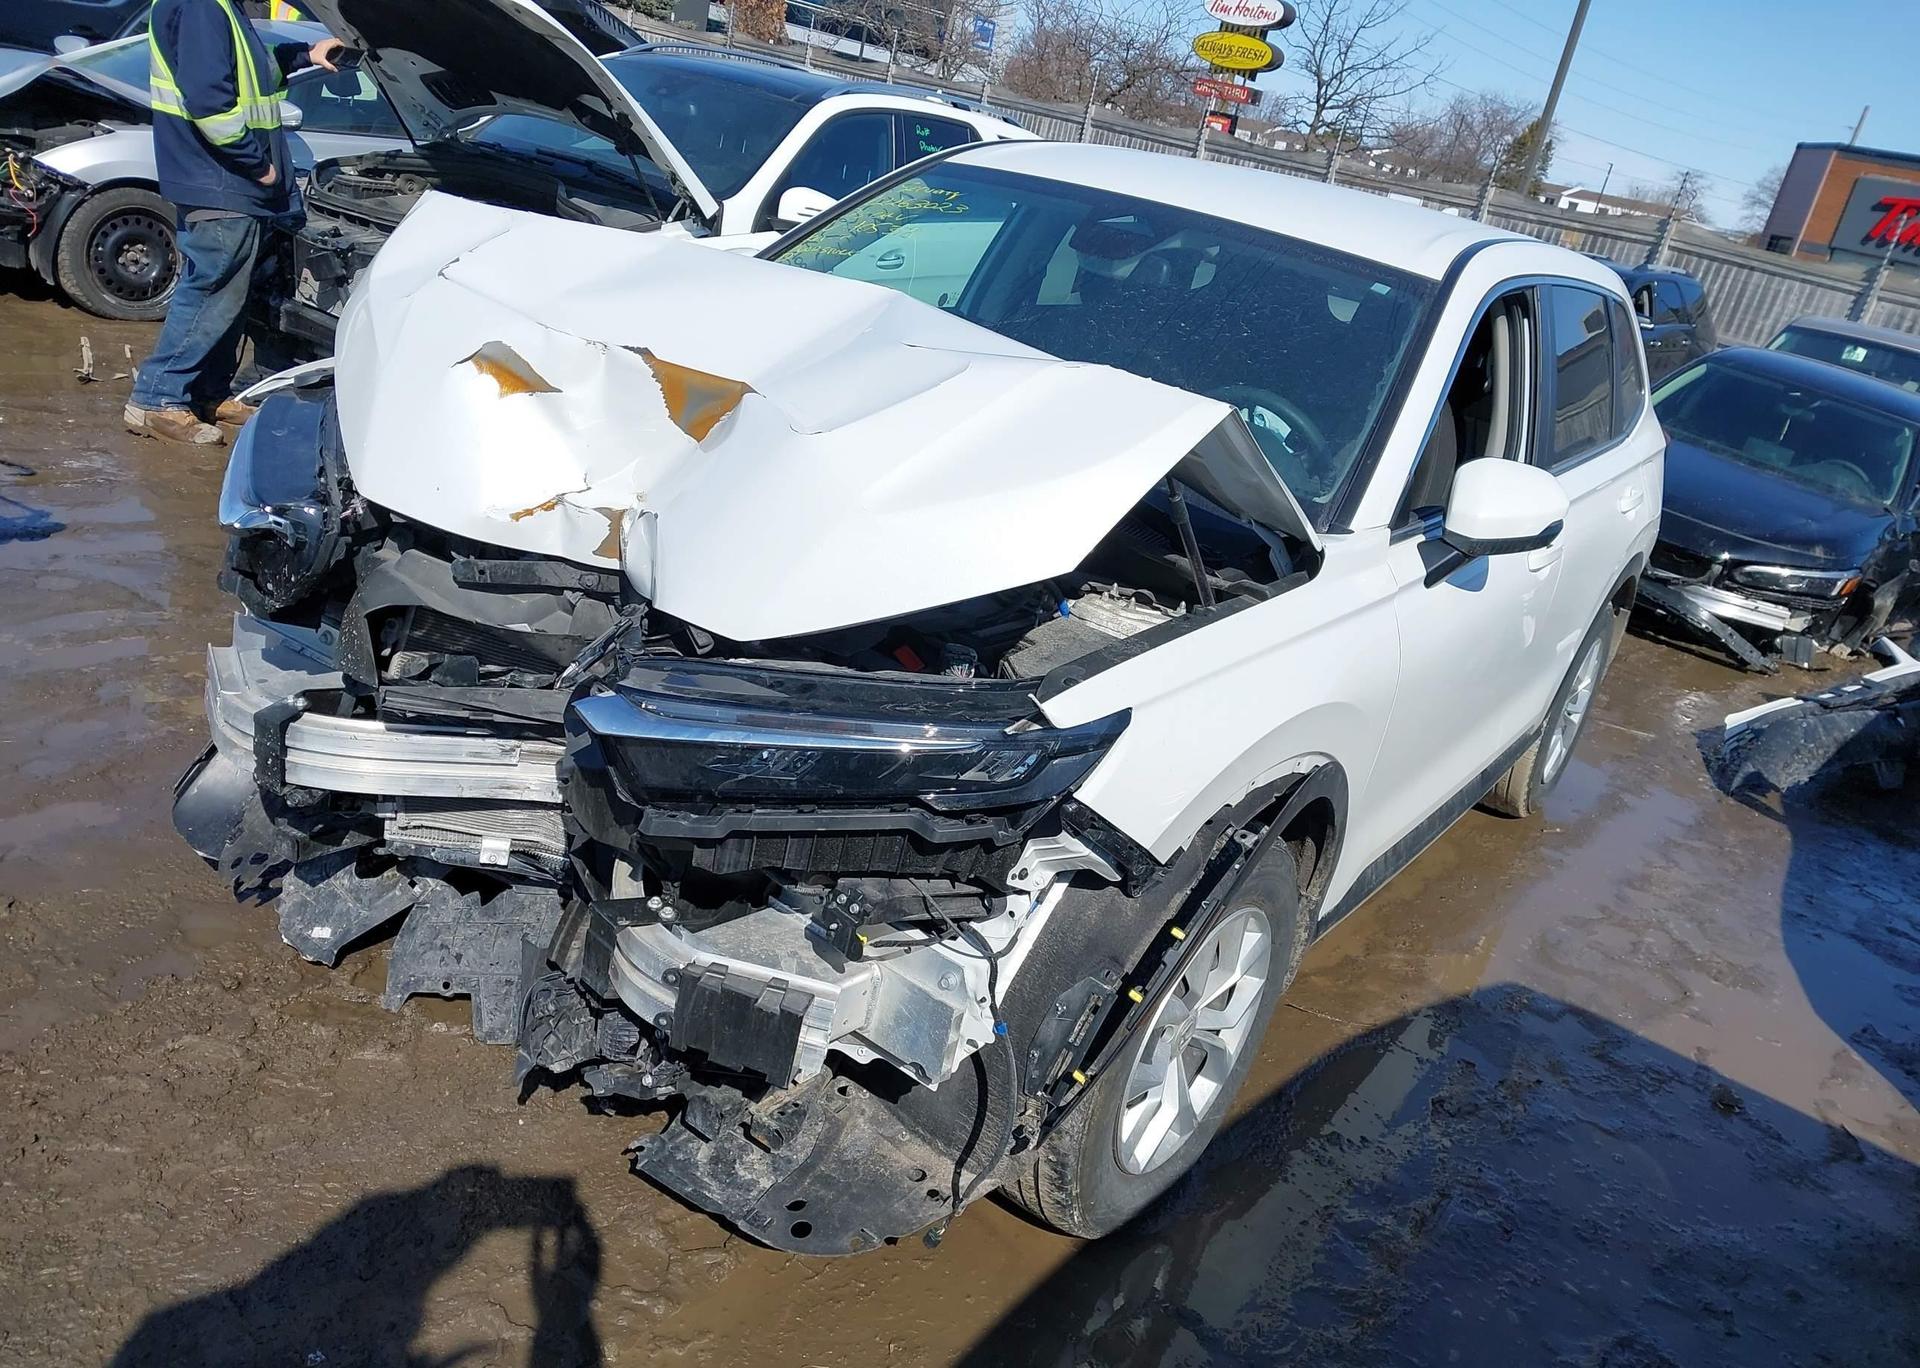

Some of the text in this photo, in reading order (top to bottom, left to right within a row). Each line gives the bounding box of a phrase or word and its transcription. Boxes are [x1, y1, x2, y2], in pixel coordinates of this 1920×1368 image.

[1210, 0, 1278, 20] Tim Hortons
[1197, 40, 1267, 62] ALWAYS FRESH
[1223, 86, 1248, 100] THRU
